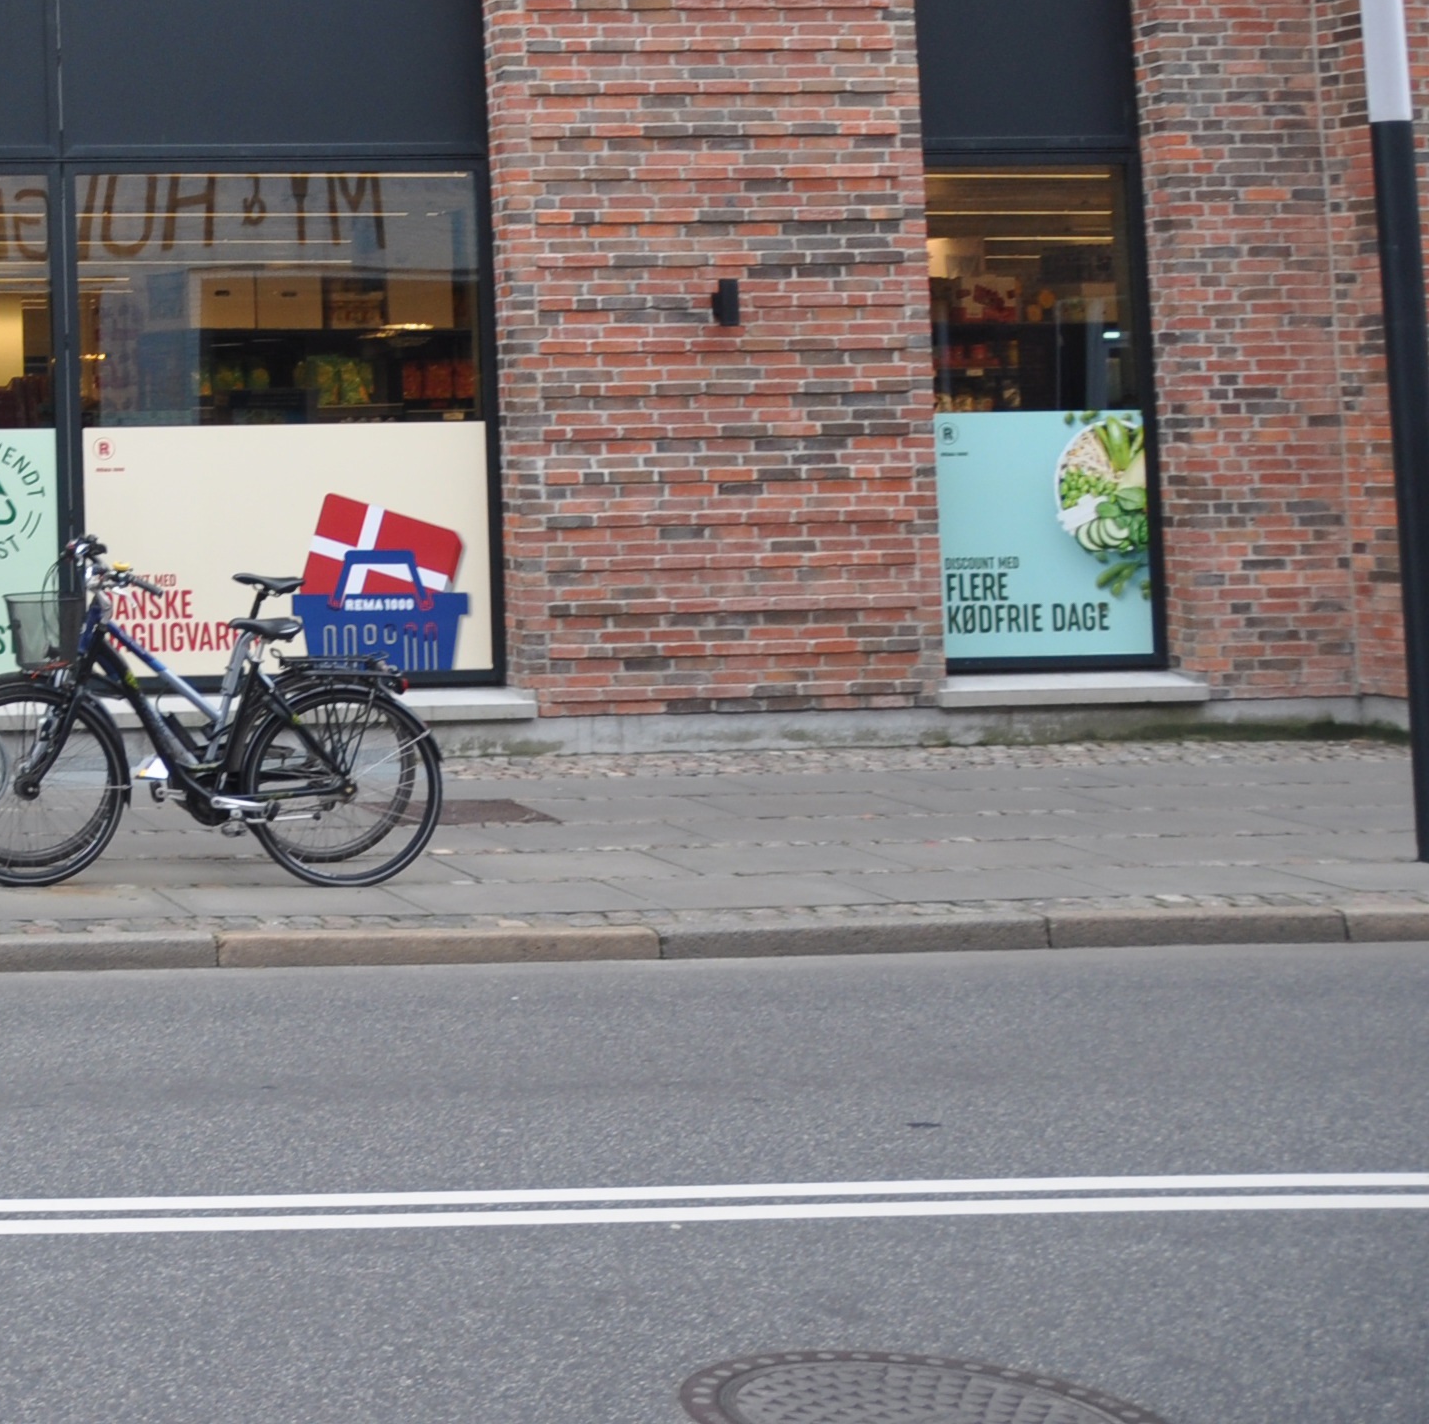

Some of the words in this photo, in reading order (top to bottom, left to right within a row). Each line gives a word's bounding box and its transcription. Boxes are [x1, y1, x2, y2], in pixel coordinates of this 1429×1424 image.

[944, 557, 995, 571] DISCOUNT
[998, 556, 1020, 570] MED
[153, 574, 177, 588] MED
[945, 572, 1010, 603] FLERE
[946, 603, 1044, 636] KØDFRIE
[1052, 602, 1111, 633] DAGE
[108, 622, 262, 655] AGLIGVAR
